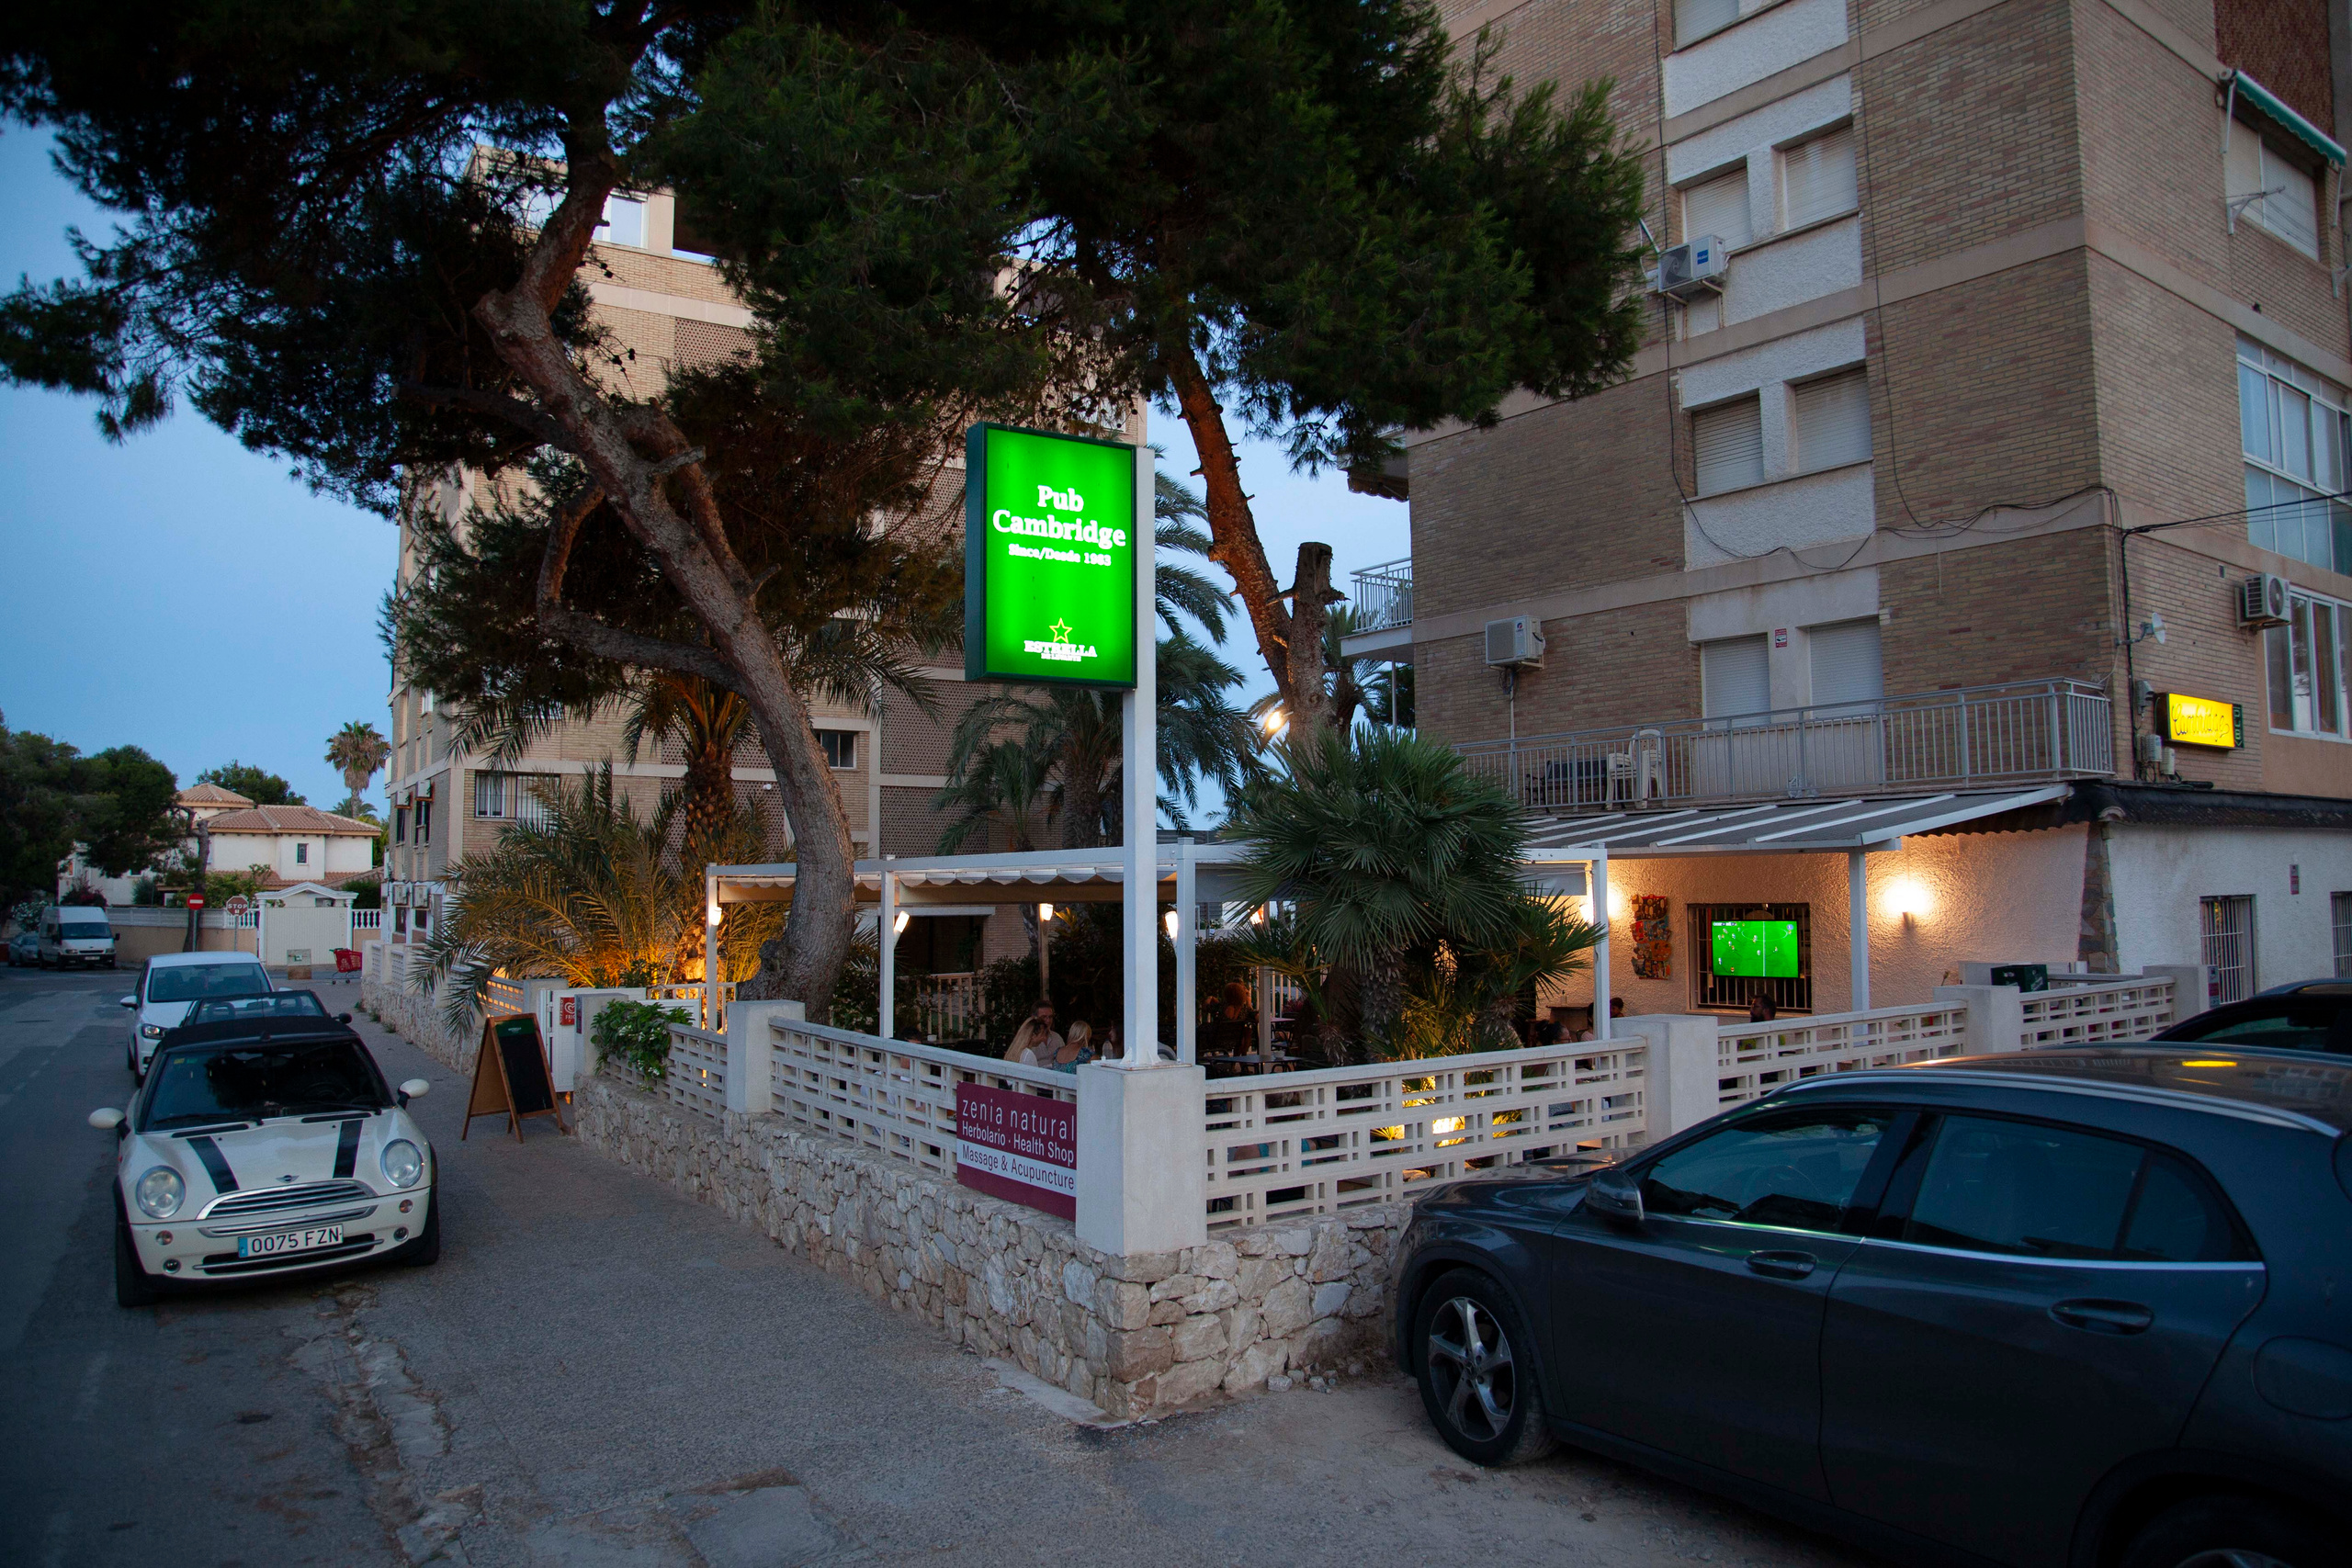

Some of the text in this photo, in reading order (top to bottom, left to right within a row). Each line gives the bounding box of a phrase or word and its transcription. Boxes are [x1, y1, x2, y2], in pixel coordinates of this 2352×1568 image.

[1037, 485, 1084, 512] Pub
[992, 509, 1125, 549] Cambridge
[1023, 640, 1097, 658] ESTRELLA
[962, 1099, 1075, 1141] zenia natural
[962, 1120, 1074, 1167] Herbolario Health Shop
[962, 1144, 1074, 1190] Massage & Acupuncture
[252, 1226, 339, 1253] 0075 FZN
